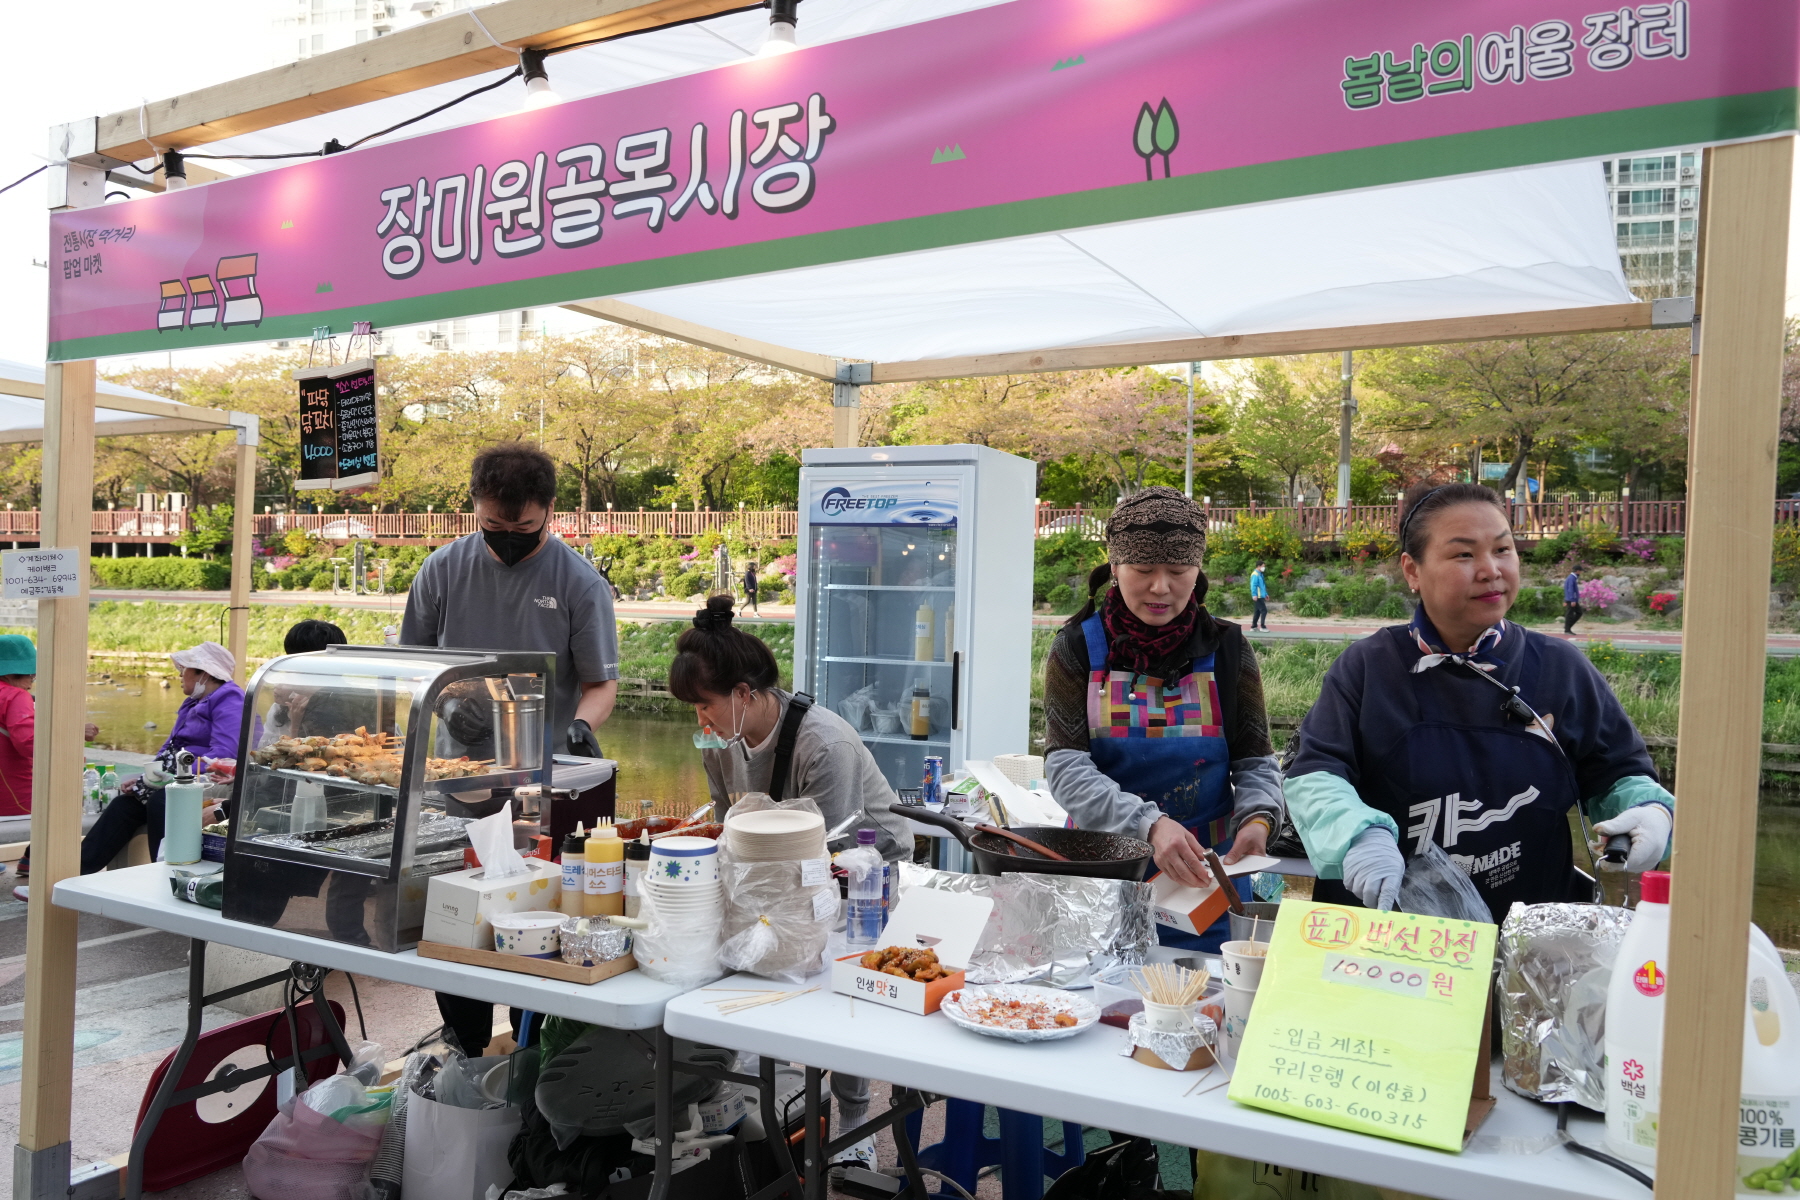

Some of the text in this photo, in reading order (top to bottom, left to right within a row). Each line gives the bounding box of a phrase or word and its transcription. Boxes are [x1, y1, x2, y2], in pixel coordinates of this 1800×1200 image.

[1582, 0, 1689, 71] 장터
[376, 93, 836, 280] 장미원골목시장
[63, 225, 136, 253] 전통시장 먹거리
[63, 252, 102, 280] 팝업 마켓
[302, 409, 333, 434] 닭꼬치
[824, 498, 898, 512] FREETOP
[27, 564, 57, 573] 케이뱅크
[1471, 840, 1522, 875] MADE
[588, 879, 607, 889] 소스
[1308, 910, 1478, 964] 표고 버섯 강정
[1432, 972, 1454, 998] 원
[1287, 1027, 1376, 1058] 입금 계좌
[1269, 1056, 1345, 1088] 우리은행
[1621, 1079, 1646, 1100] 백설
[1740, 1107, 1784, 1126] 100%
[1739, 1125, 1796, 1148] 콩기름
